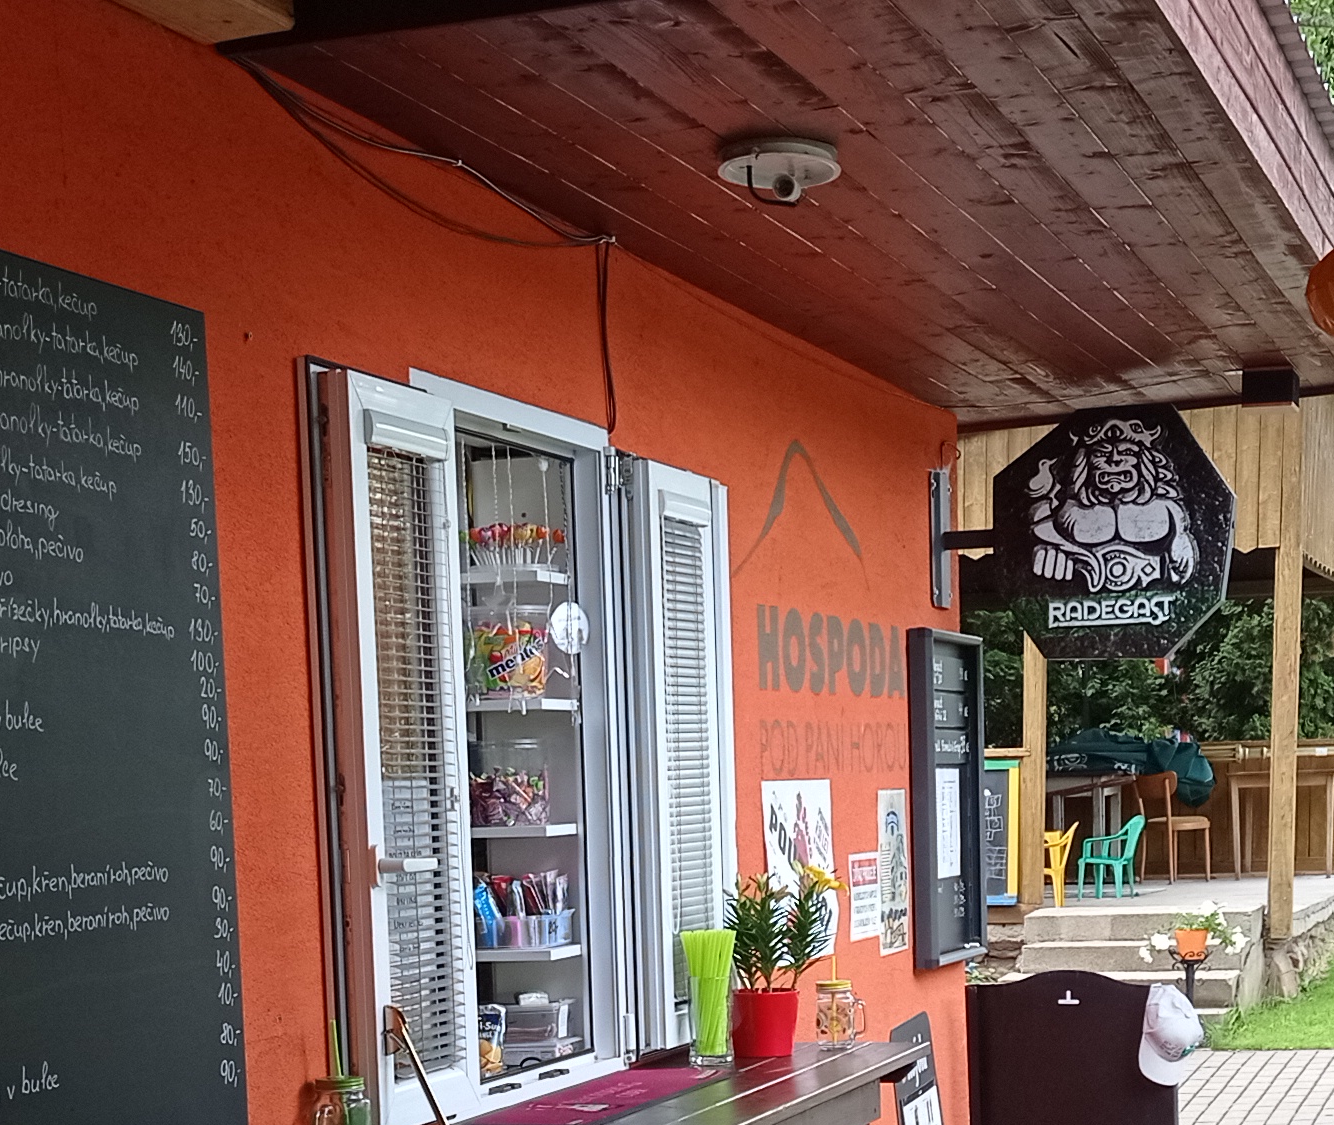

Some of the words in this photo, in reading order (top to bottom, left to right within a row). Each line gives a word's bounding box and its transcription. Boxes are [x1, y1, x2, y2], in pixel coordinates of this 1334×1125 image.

[1049, 597, 1175, 629] RADEGAST
[756, 604, 905, 698] HOSPODA
[760, 719, 797, 777] POD
[806, 713, 850, 775] PANÍ
[852, 722, 907, 772] HOROU
